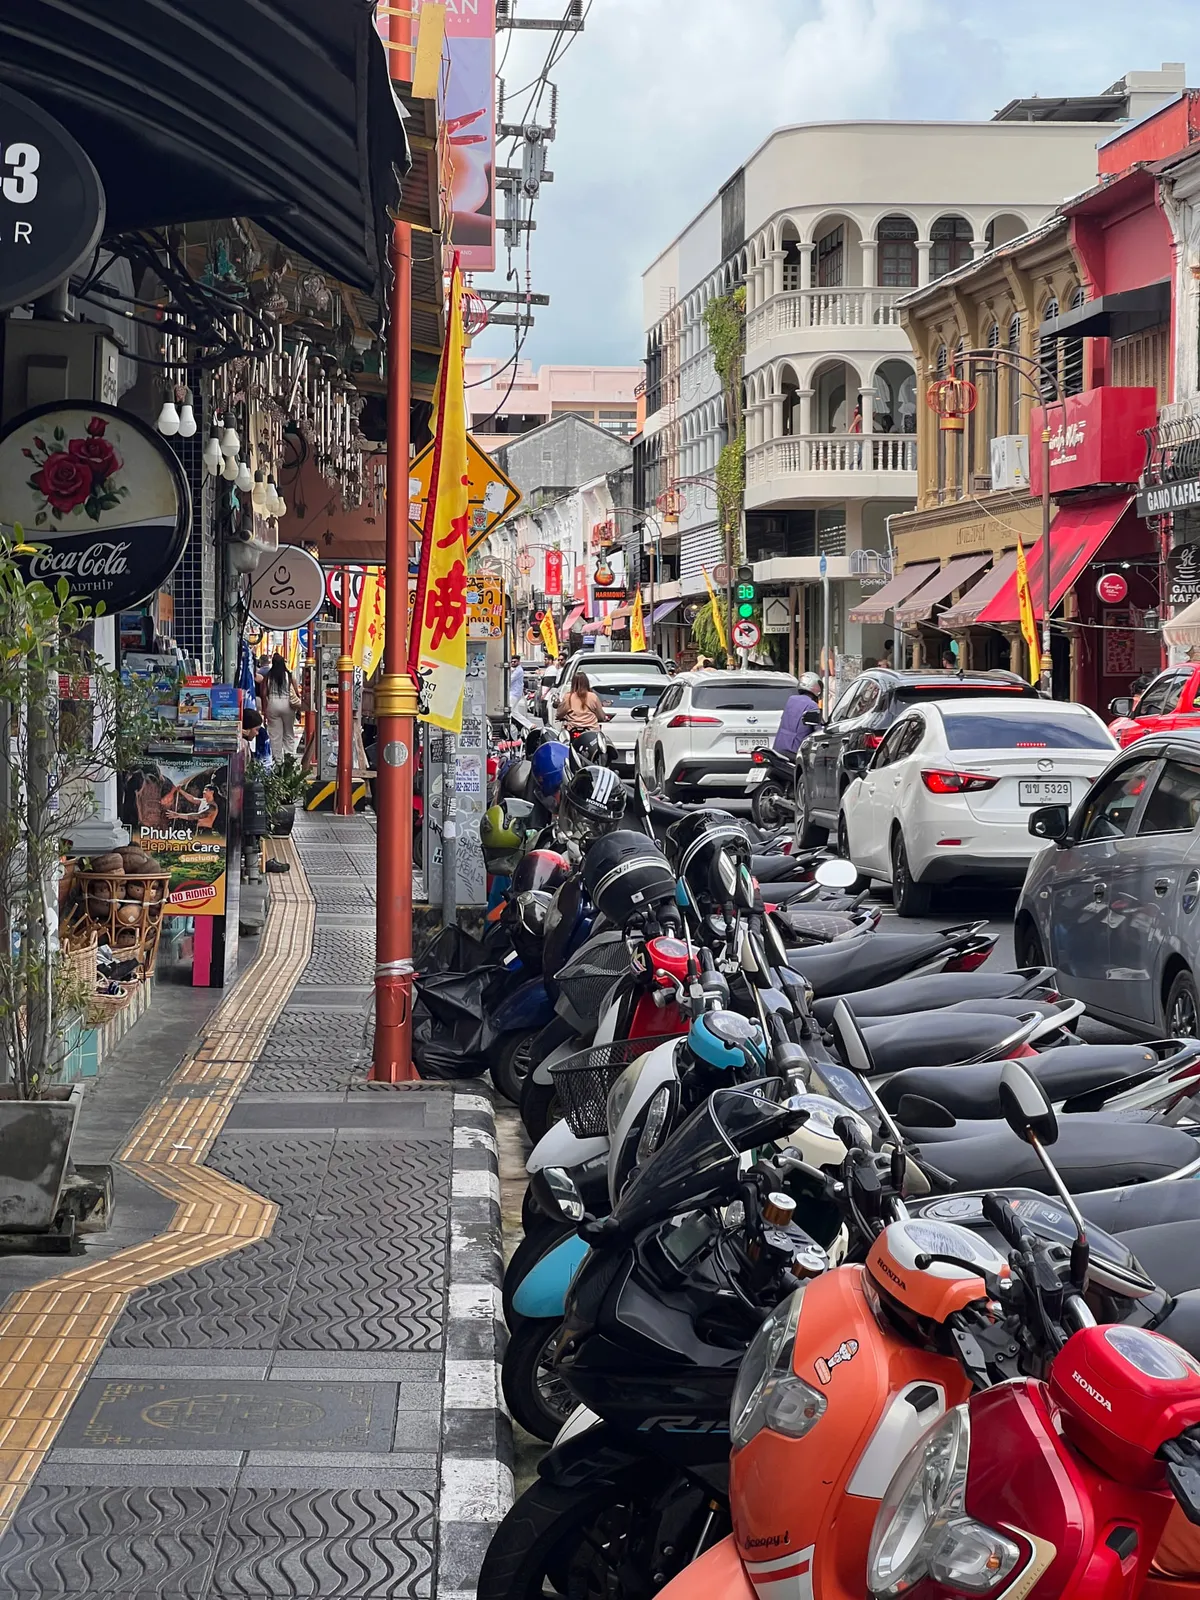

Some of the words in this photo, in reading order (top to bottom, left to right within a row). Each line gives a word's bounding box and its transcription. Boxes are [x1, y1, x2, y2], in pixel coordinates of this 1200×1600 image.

[0, 142, 40, 204] 3
[1147, 488, 1170, 511] GANO
[29, 541, 132, 579] Coca-Cola
[595, 591, 626, 599] HARMONIC
[252, 600, 312, 610] MASSAGE
[1044, 783, 1069, 794] 5329
[585, 797, 608, 811] HONDA
[140, 826, 193, 841] Phuket
[180, 855, 219, 863] Sanctuary
[171, 891, 185, 903] NO
[185, 886, 214, 900] RIDING
[876, 1257, 907, 1292] HONDA
[1072, 1370, 1112, 1413] HONDA
